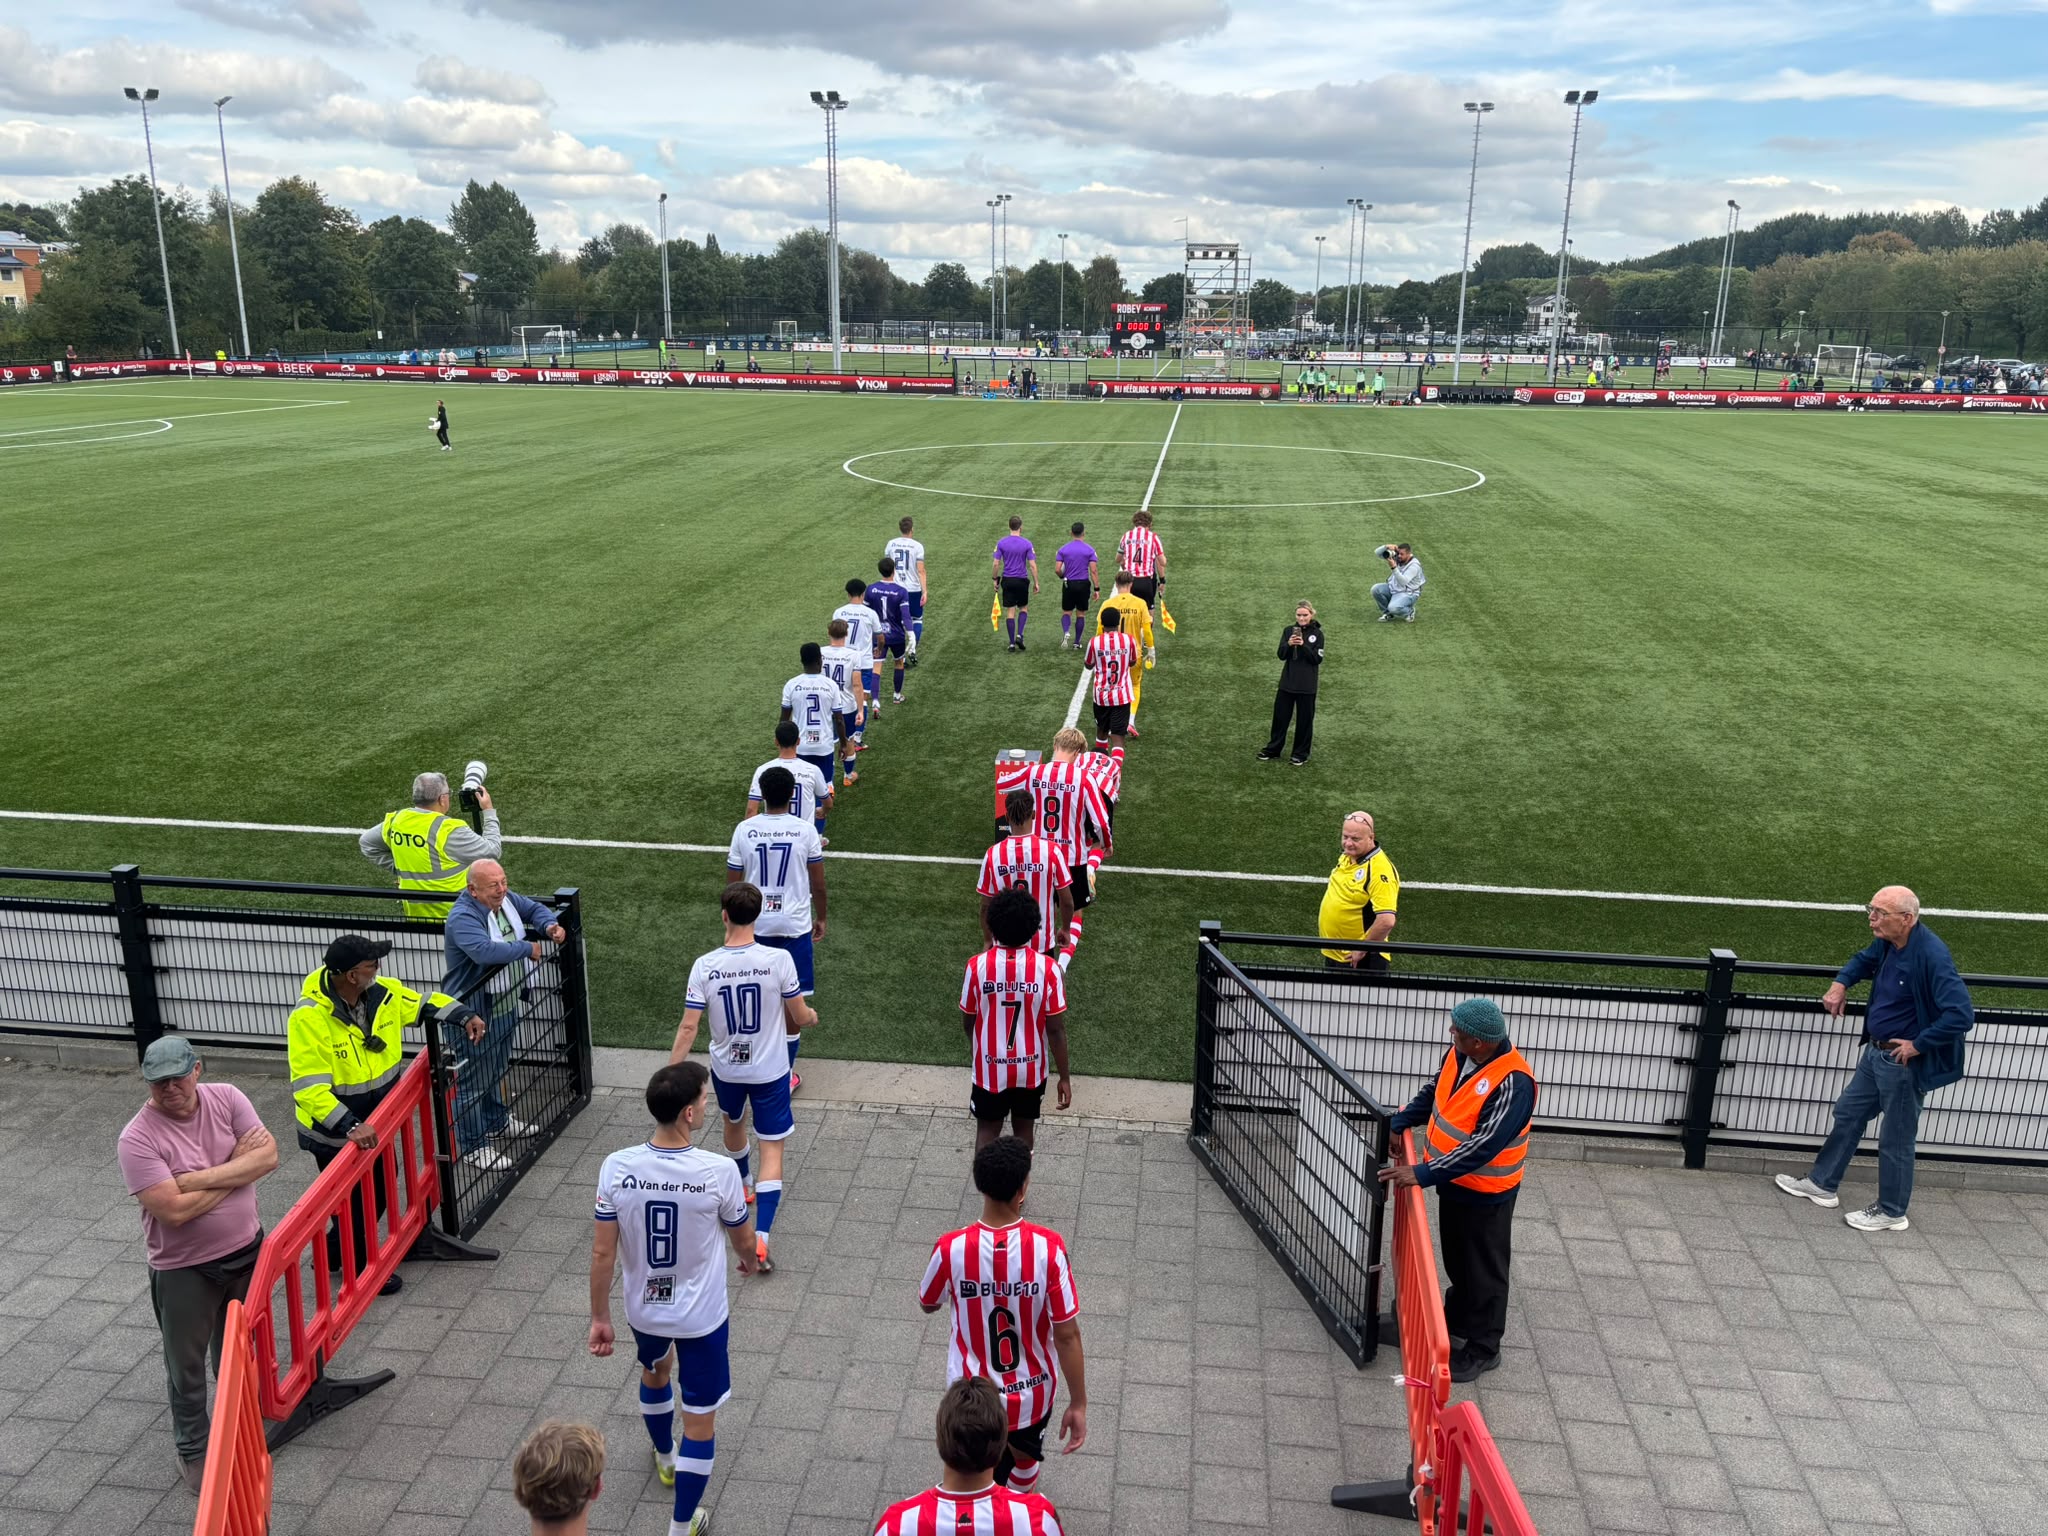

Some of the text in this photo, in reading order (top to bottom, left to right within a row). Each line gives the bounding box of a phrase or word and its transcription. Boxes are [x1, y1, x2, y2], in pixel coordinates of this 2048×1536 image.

[1116, 303, 1141, 314] ROBEY
[633, 371, 673, 382] LOGIX
[1667, 391, 1717, 402] Roodenburg
[894, 549, 910, 571] 21
[1132, 547, 1142, 566] 4
[880, 596, 887, 620] 1
[823, 664, 846, 691] 14
[1107, 660, 1119, 685] 3
[806, 694, 821, 726] 2
[1041, 781, 1076, 793] BLUE10
[1043, 795, 1060, 833] 8
[754, 842, 793, 887] 17
[1009, 863, 1044, 874] BLUE10
[721, 971, 736, 979] Van
[752, 968, 771, 976] Poel
[996, 981, 1039, 994] BLUE10
[717, 982, 762, 1036] 10
[1001, 1000, 1022, 1050] 7
[993, 1057, 1008, 1065] VAN
[1022, 1054, 1039, 1064] HELM
[638, 1180, 706, 1193] Van der Poel
[645, 1200, 679, 1270] 8
[981, 1281, 1040, 1298] BLUE10
[988, 1305, 1020, 1373] 6
[1007, 1380, 1026, 1394] DER
[1026, 1373, 1049, 1388] HELM
